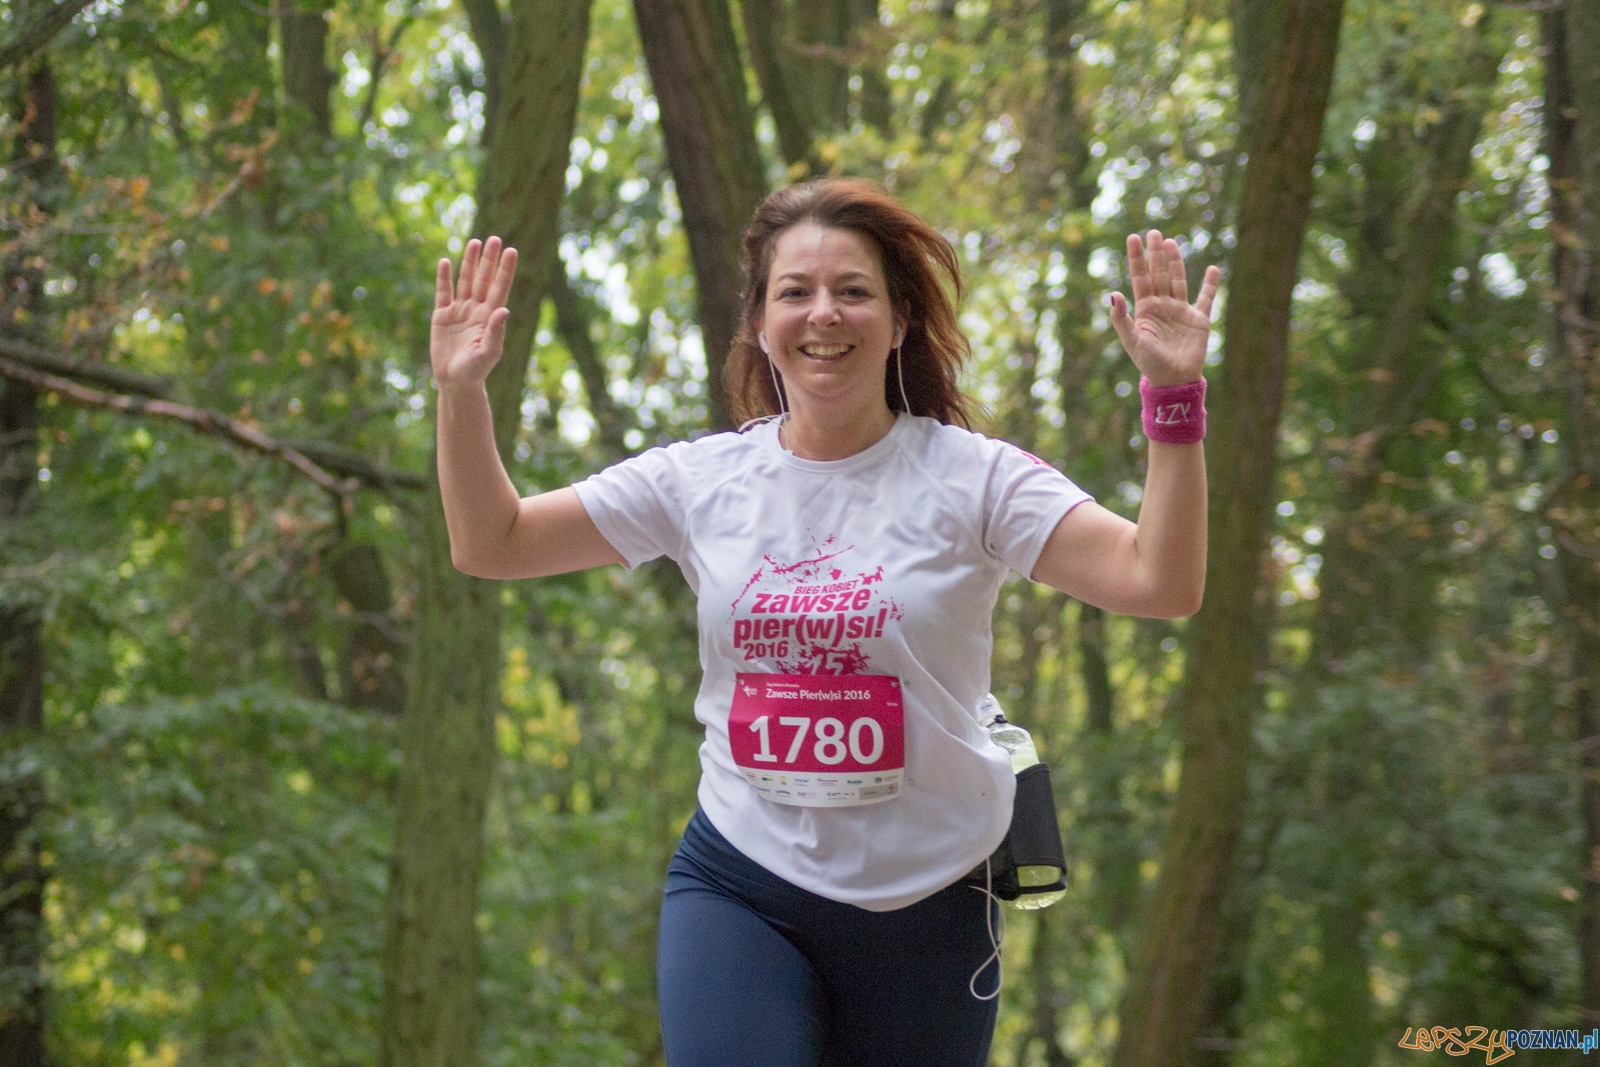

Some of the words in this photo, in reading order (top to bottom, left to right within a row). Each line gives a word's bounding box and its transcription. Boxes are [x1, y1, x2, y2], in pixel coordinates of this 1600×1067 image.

[795, 586, 820, 594] BIEG
[821, 580, 859, 593] KOBIET
[750, 588, 871, 614] zawsze
[733, 608, 887, 648] pier(w)si!
[743, 640, 789, 661] 2016
[765, 688, 798, 699] Zawsze
[800, 689, 842, 701] Pier(w)si
[843, 690, 871, 701] 2016
[749, 715, 884, 765] 1780
